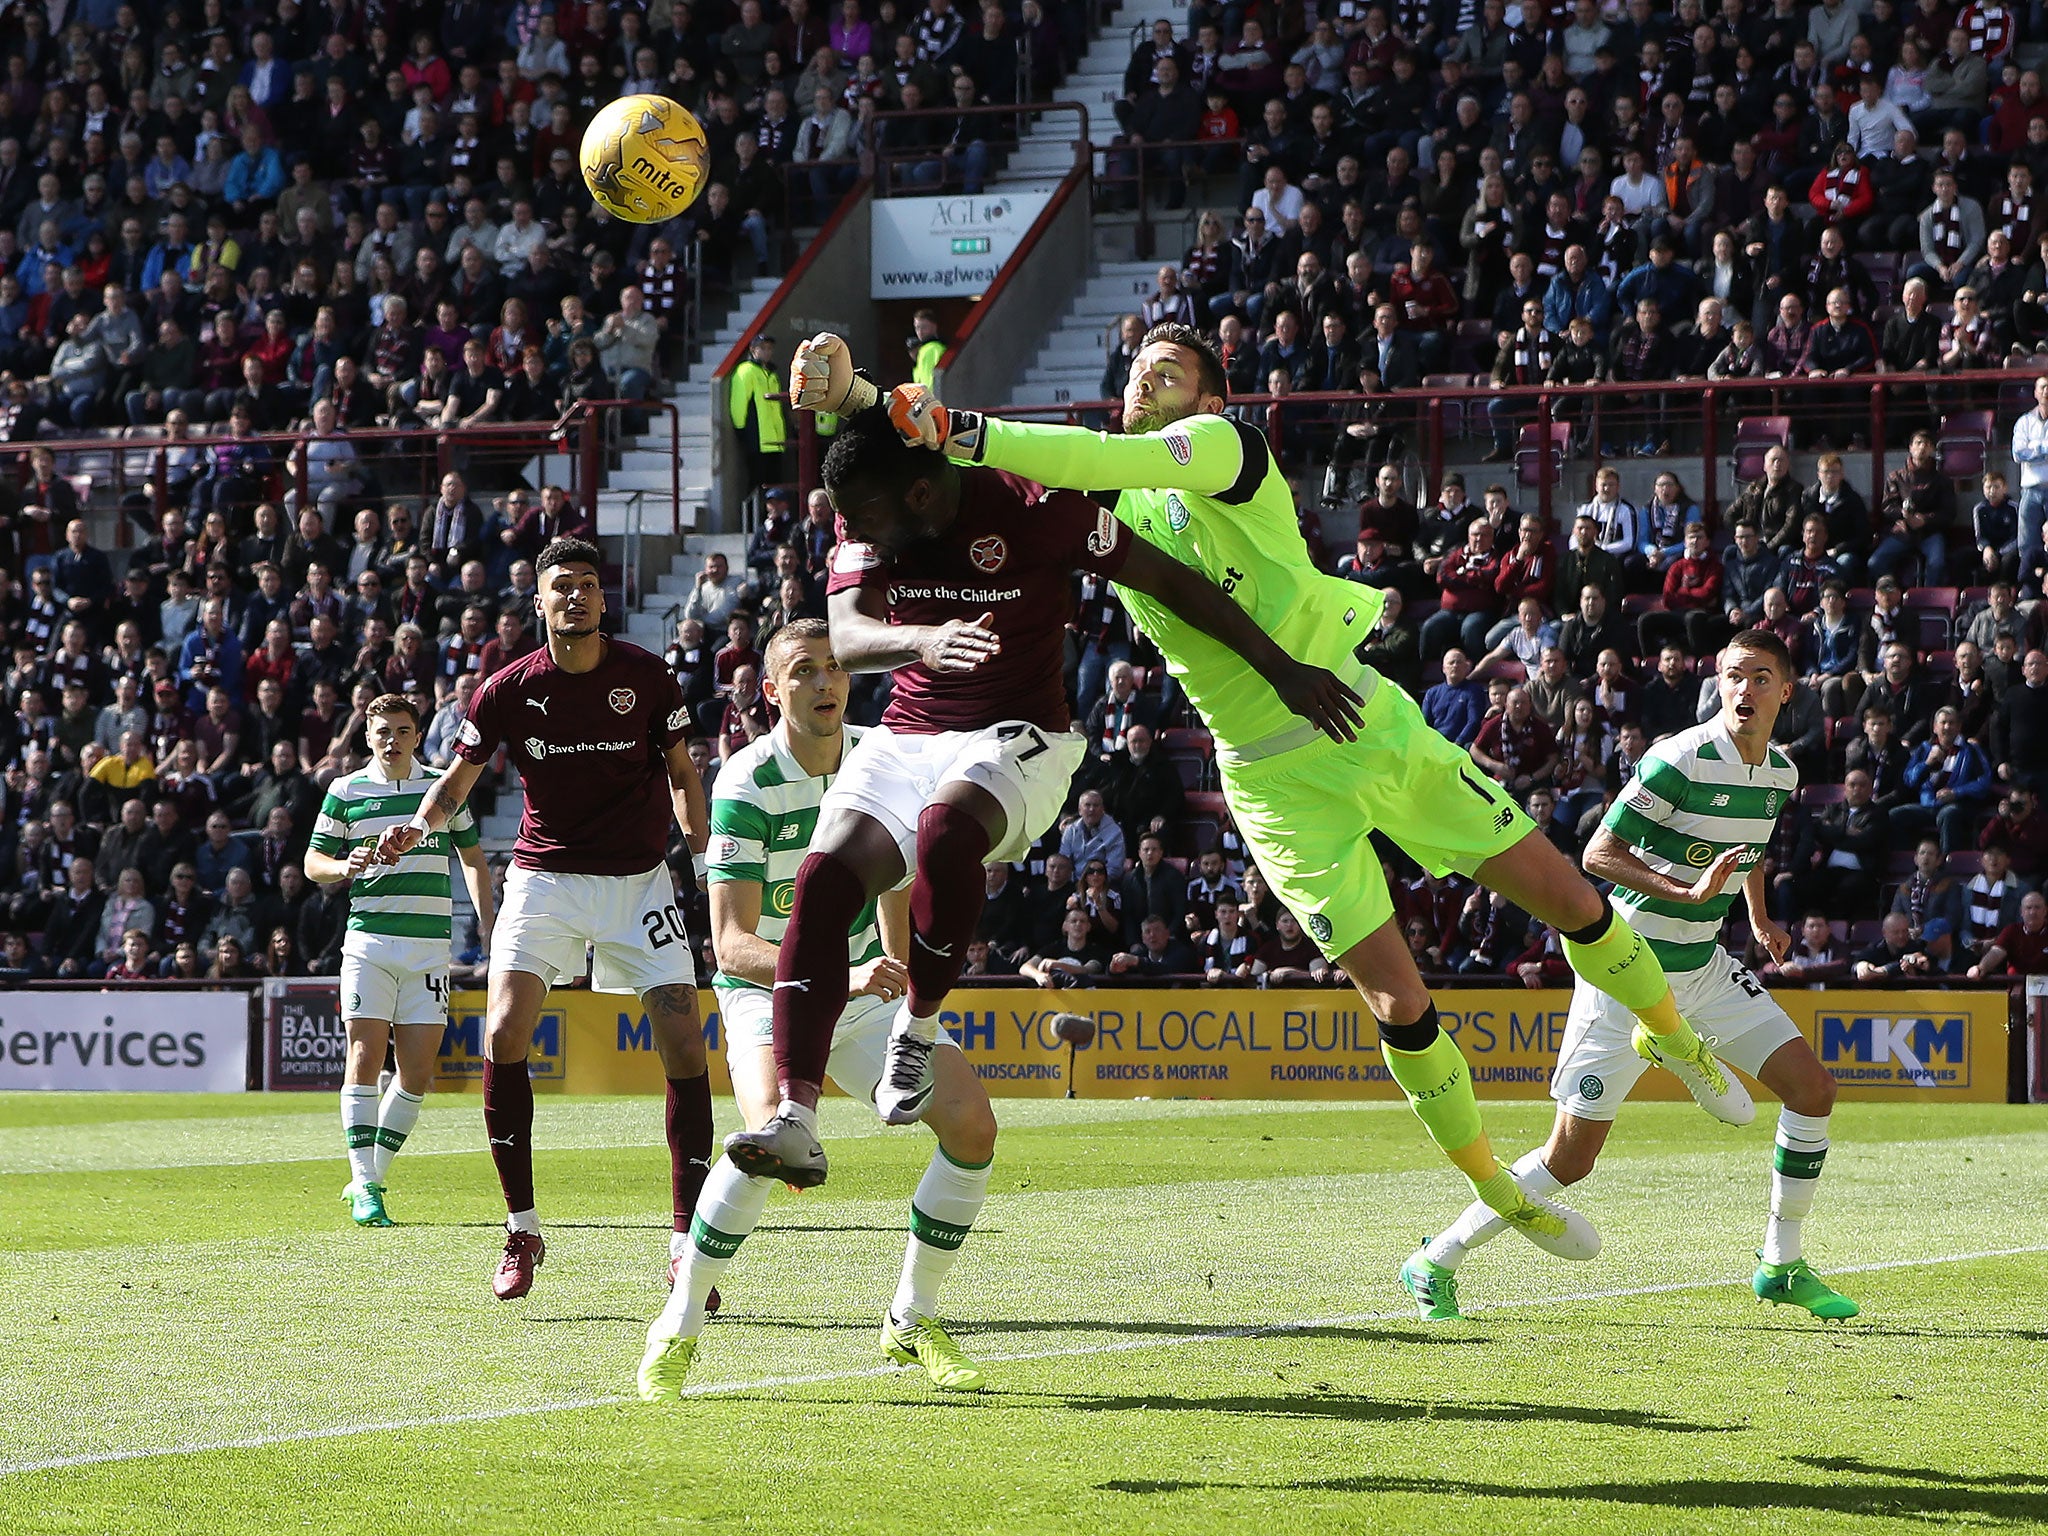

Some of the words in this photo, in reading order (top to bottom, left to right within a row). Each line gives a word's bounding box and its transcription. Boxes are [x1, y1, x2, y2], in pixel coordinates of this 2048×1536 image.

[631, 157, 685, 199] mitre
[882, 264, 1000, 287] www.aglweal
[899, 585, 932, 599] Save
[934, 586, 958, 600] the
[960, 586, 1021, 603] Children
[548, 744, 575, 755] Save
[576, 742, 595, 753] the
[1459, 766, 1496, 805] 1
[642, 904, 687, 949] 20
[283, 1005, 305, 1016] THE
[281, 1015, 345, 1037] BALL
[437, 1014, 560, 1056] MM
[1010, 1011, 1124, 1052] YOR
[1136, 1010, 1272, 1052] LOCAL
[1283, 1010, 1497, 1053] BUILR'S
[0, 1015, 206, 1067] ervices
[281, 1037, 346, 1059] ROOM
[1821, 1017, 1964, 1067] MKM
[280, 1061, 323, 1075] SPORTS
[1096, 1064, 1149, 1080] BRICKS
[1152, 1064, 1164, 1080] &
[1167, 1064, 1229, 1081] MORTAR
[1270, 1065, 1347, 1081] FLOORING
[1348, 1065, 1359, 1081] &
[1469, 1066, 1544, 1083] LUMBING
[1830, 1068, 1892, 1080] BUILDING
[1896, 1068, 1957, 1080] SUPPLIES
[701, 1234, 737, 1251] CELTIC
